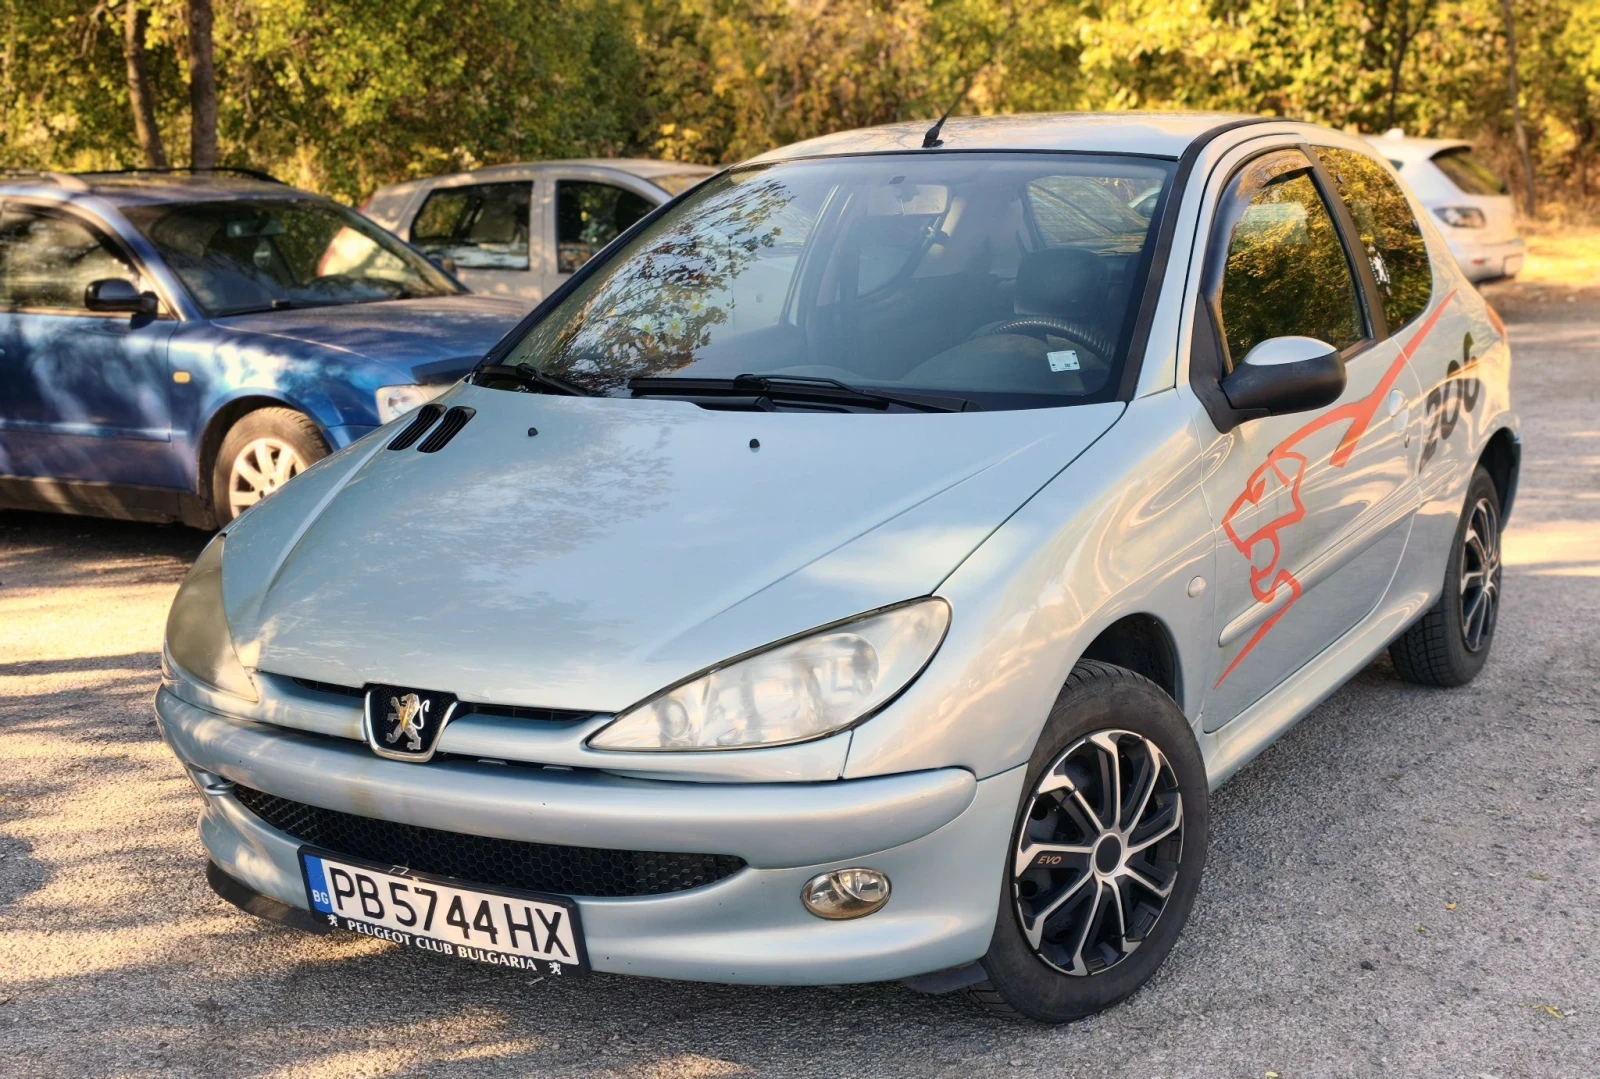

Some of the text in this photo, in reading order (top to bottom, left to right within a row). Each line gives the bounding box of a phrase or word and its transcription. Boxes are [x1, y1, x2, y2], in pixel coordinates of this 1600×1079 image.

[1419, 331, 1480, 474] 206
[1037, 855, 1062, 865] EVO
[312, 889, 330, 906] BG
[347, 919, 538, 972] PEUGEOT CLUB BULGARIA
